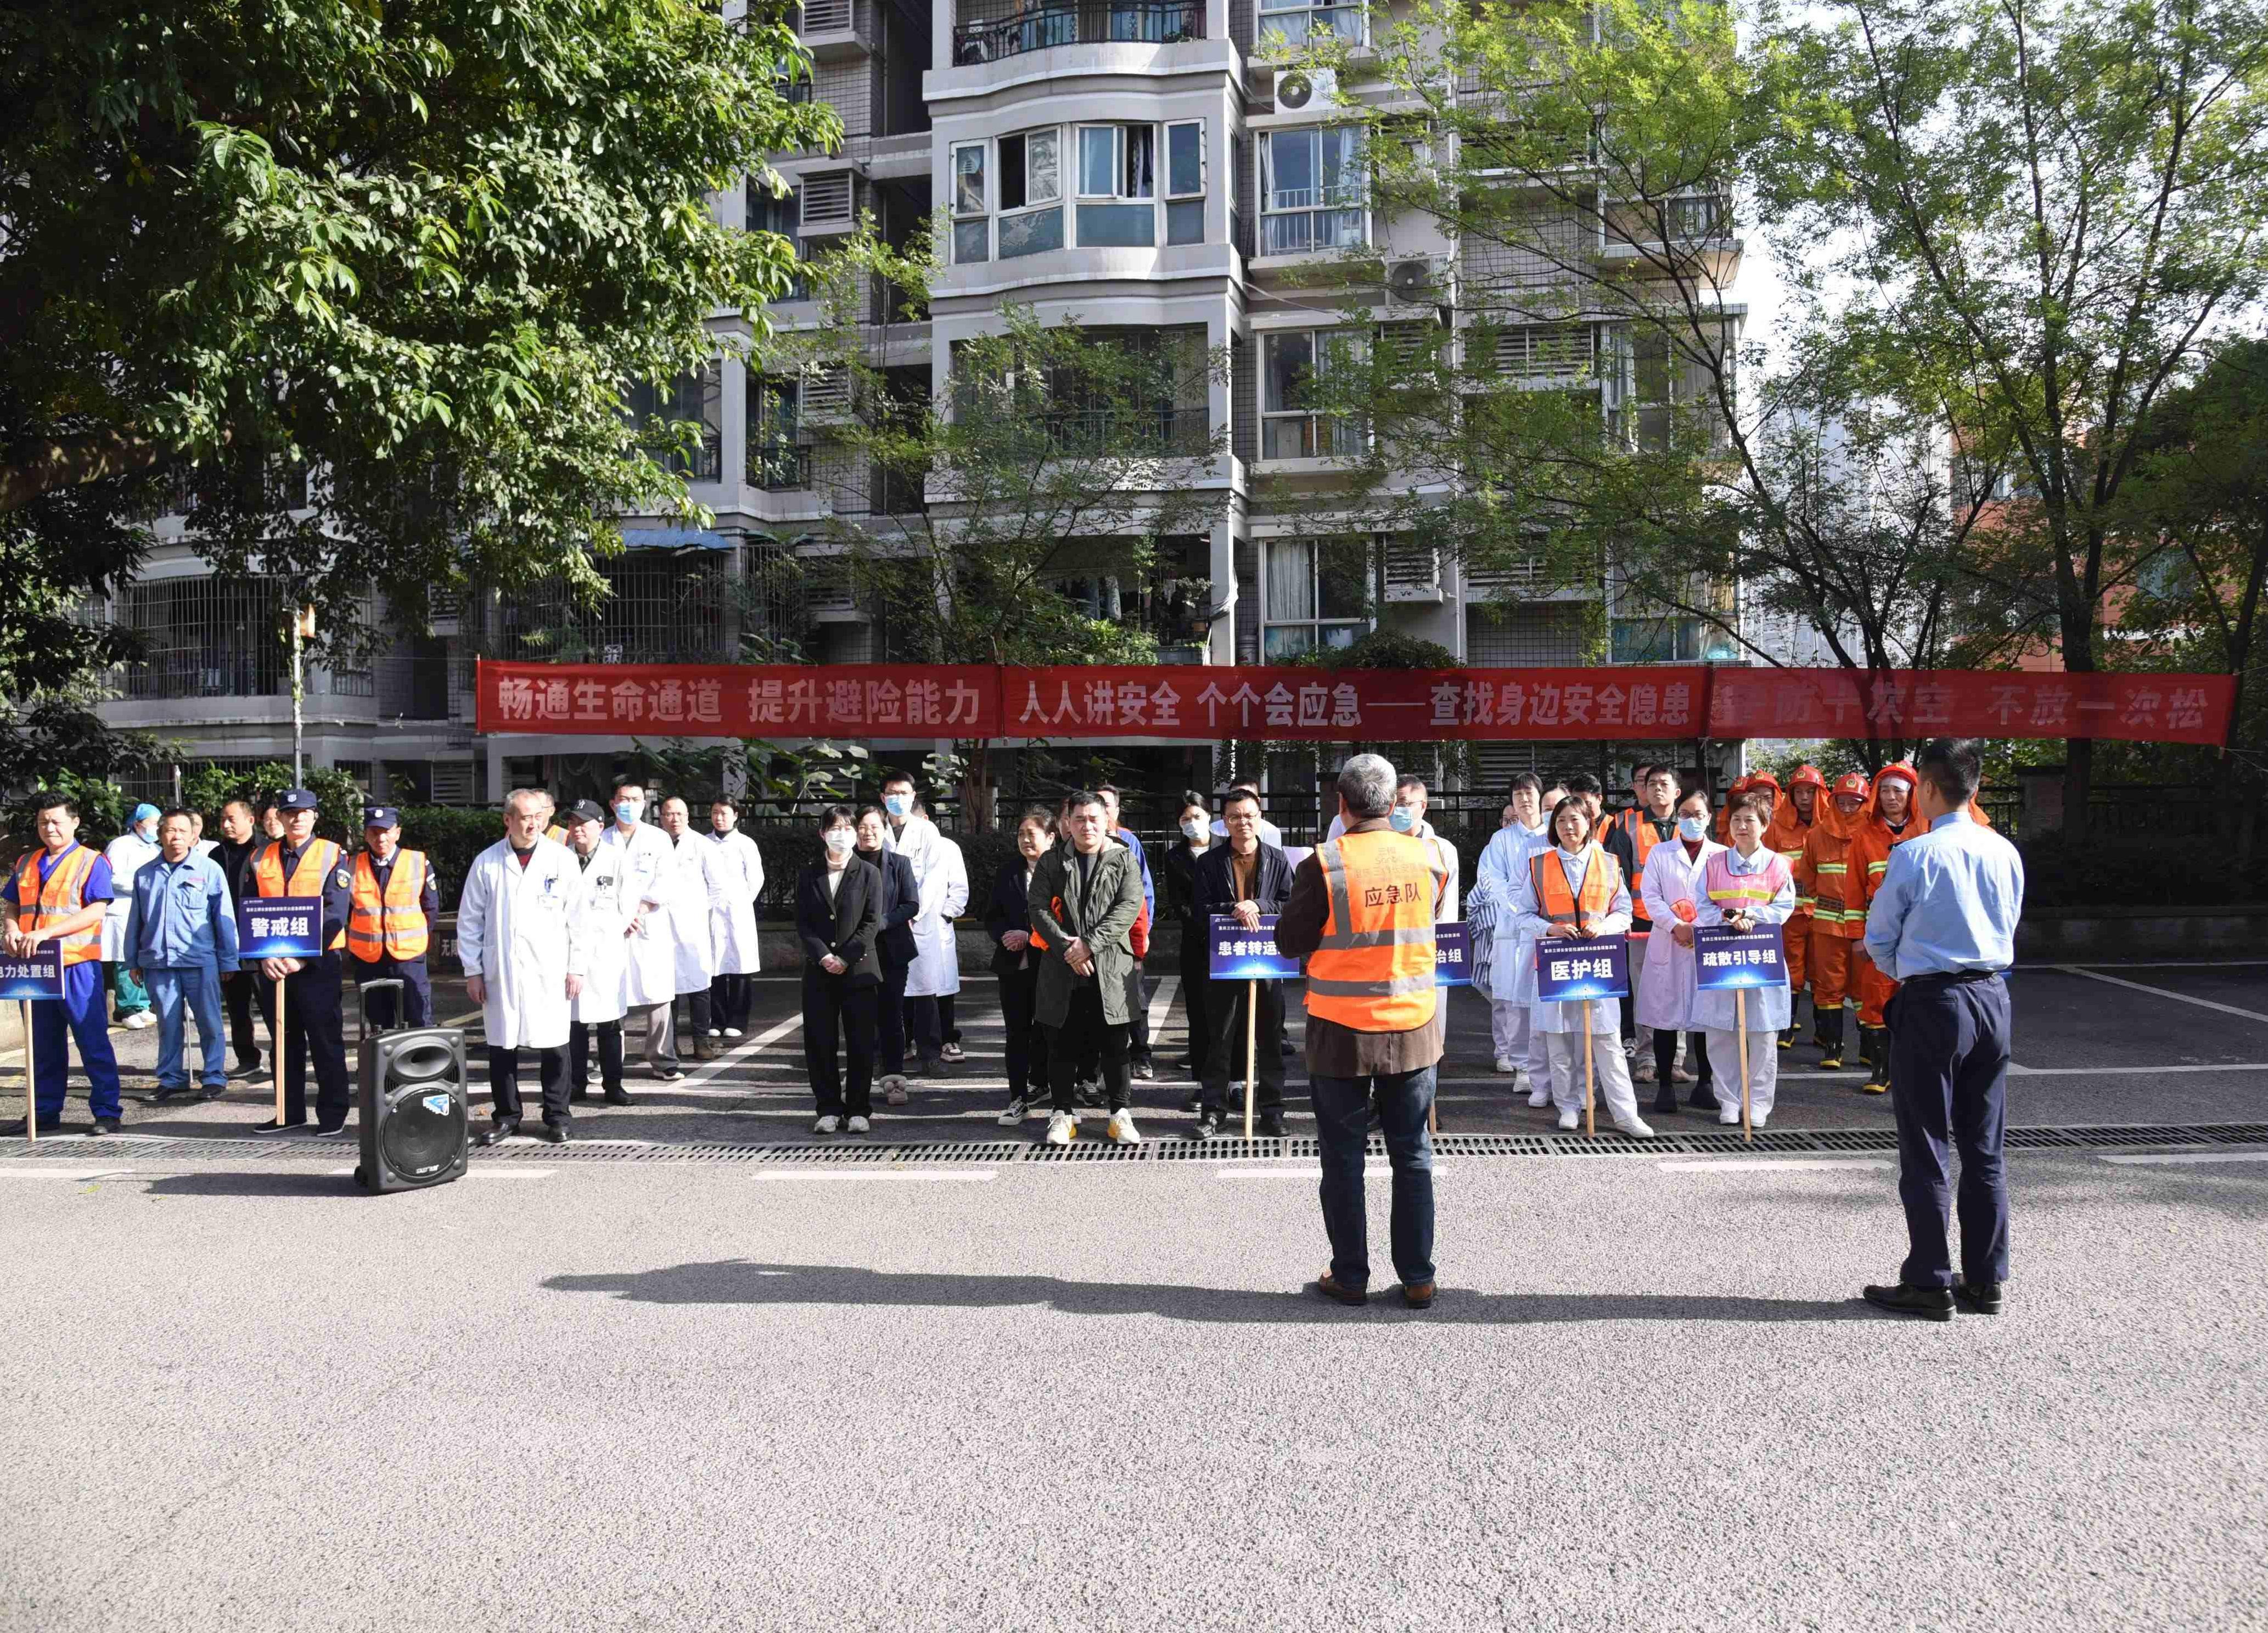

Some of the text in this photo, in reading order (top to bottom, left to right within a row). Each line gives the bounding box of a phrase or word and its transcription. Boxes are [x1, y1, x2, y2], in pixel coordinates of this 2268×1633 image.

[499, 676, 979, 725] 畅通生命通道 提升避险能力
[1019, 680, 1181, 726] 人人讲安全
[1986, 684, 2209, 729] 不放一次松
[1365, 882, 1422, 908] 应急队
[251, 916, 309, 938] 警戒组
[1217, 940, 1281, 956] 患者转运
[1435, 948, 1463, 964] 治组
[1703, 949, 1777, 967] 疏散引导组
[1551, 958, 1614, 981] 医护组
